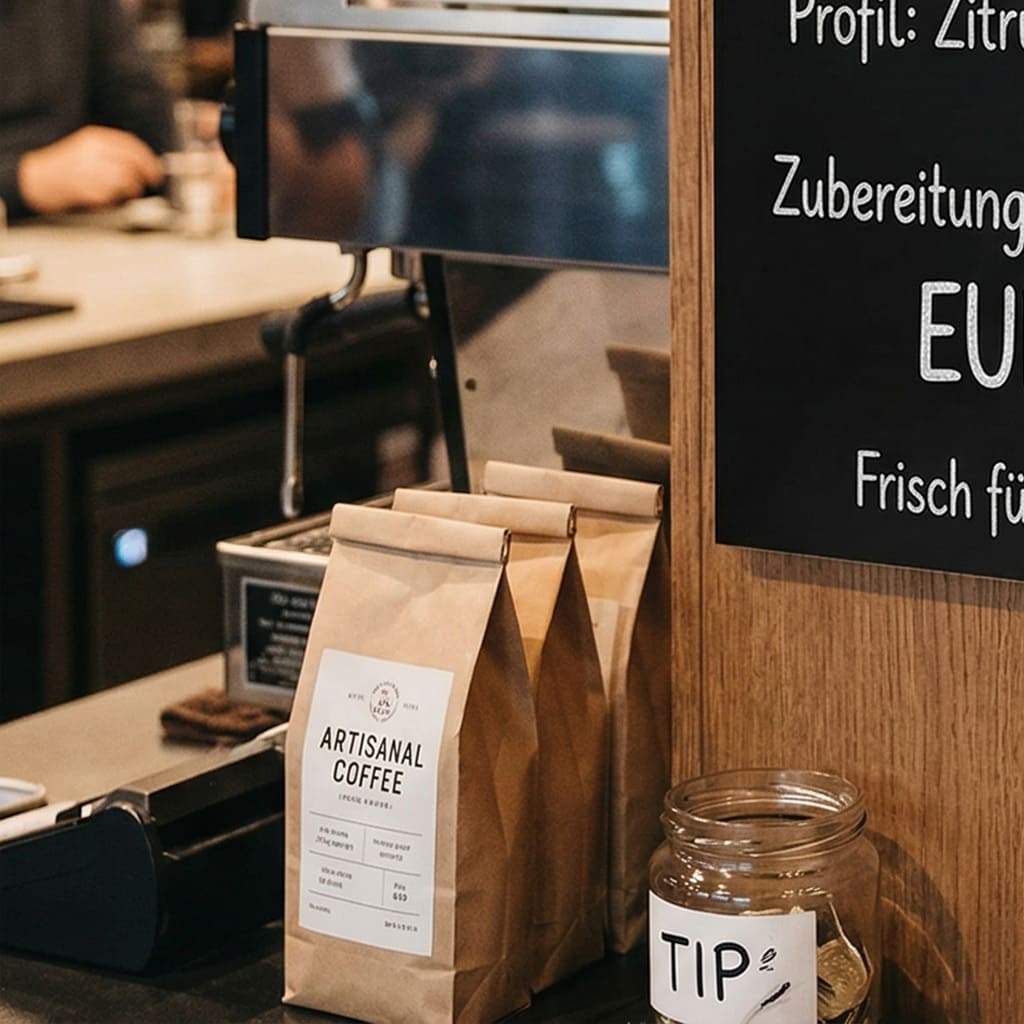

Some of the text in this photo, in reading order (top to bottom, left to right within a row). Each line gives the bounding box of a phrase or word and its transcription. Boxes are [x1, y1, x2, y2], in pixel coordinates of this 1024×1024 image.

[856, 449, 972, 519] Frisch
[319, 726, 424, 769] ARTISANAL
[332, 758, 405, 795] COFFEE
[661, 932, 750, 1002] TIP
